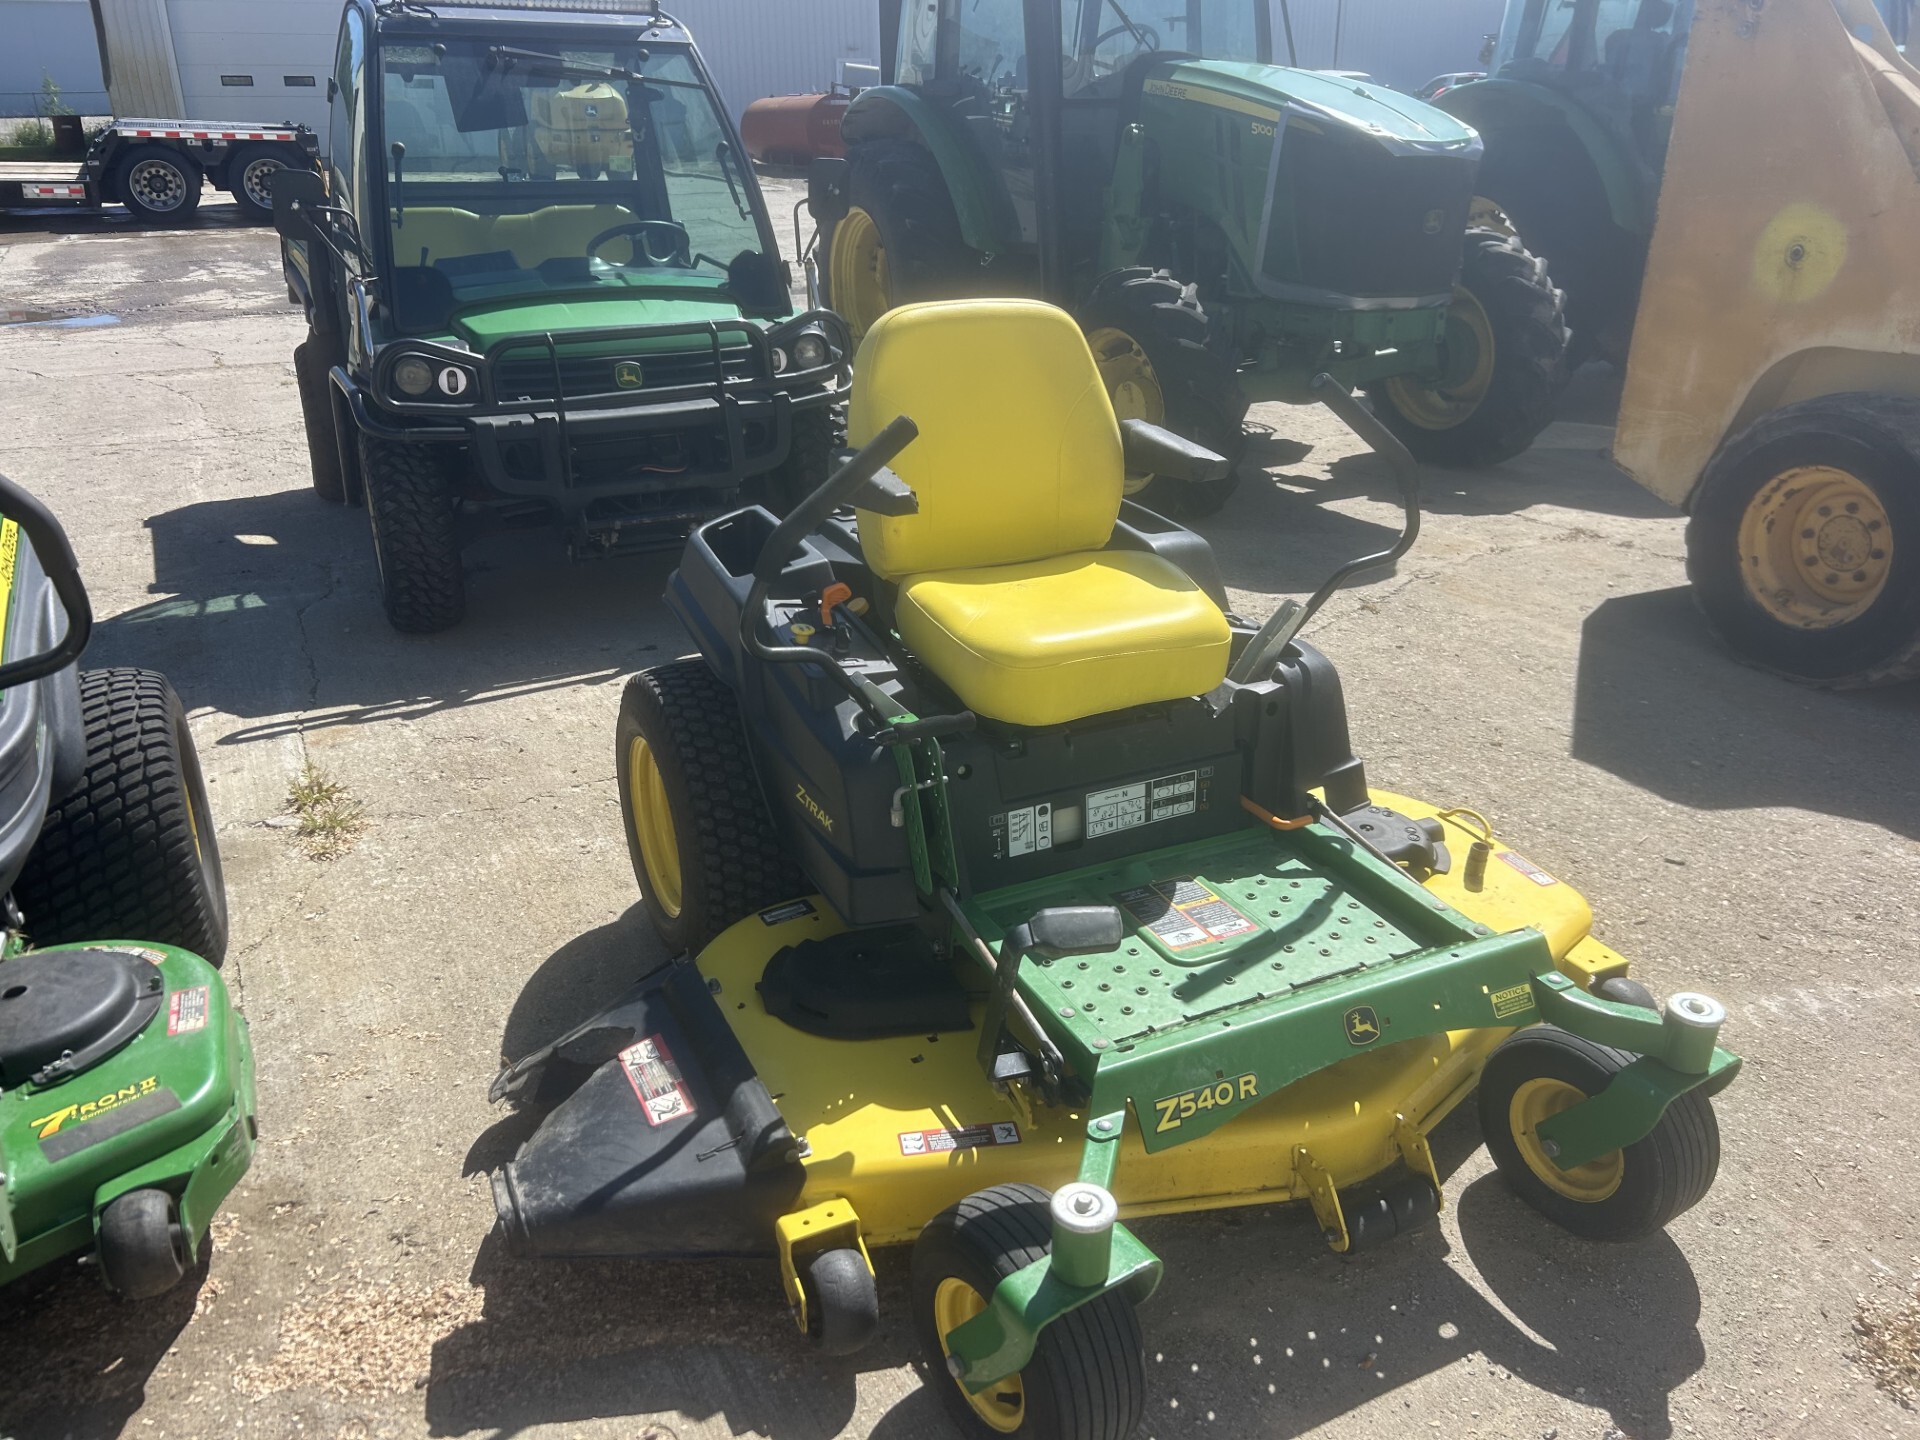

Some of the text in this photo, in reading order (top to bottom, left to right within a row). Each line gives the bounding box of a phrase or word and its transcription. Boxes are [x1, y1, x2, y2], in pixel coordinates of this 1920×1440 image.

[1150, 82, 1188, 100] JOHN DEERE
[1251, 121, 1273, 136] 5100
[1495, 986, 1527, 1002] NOTICE
[1155, 1073, 1259, 1133] Z540 R
